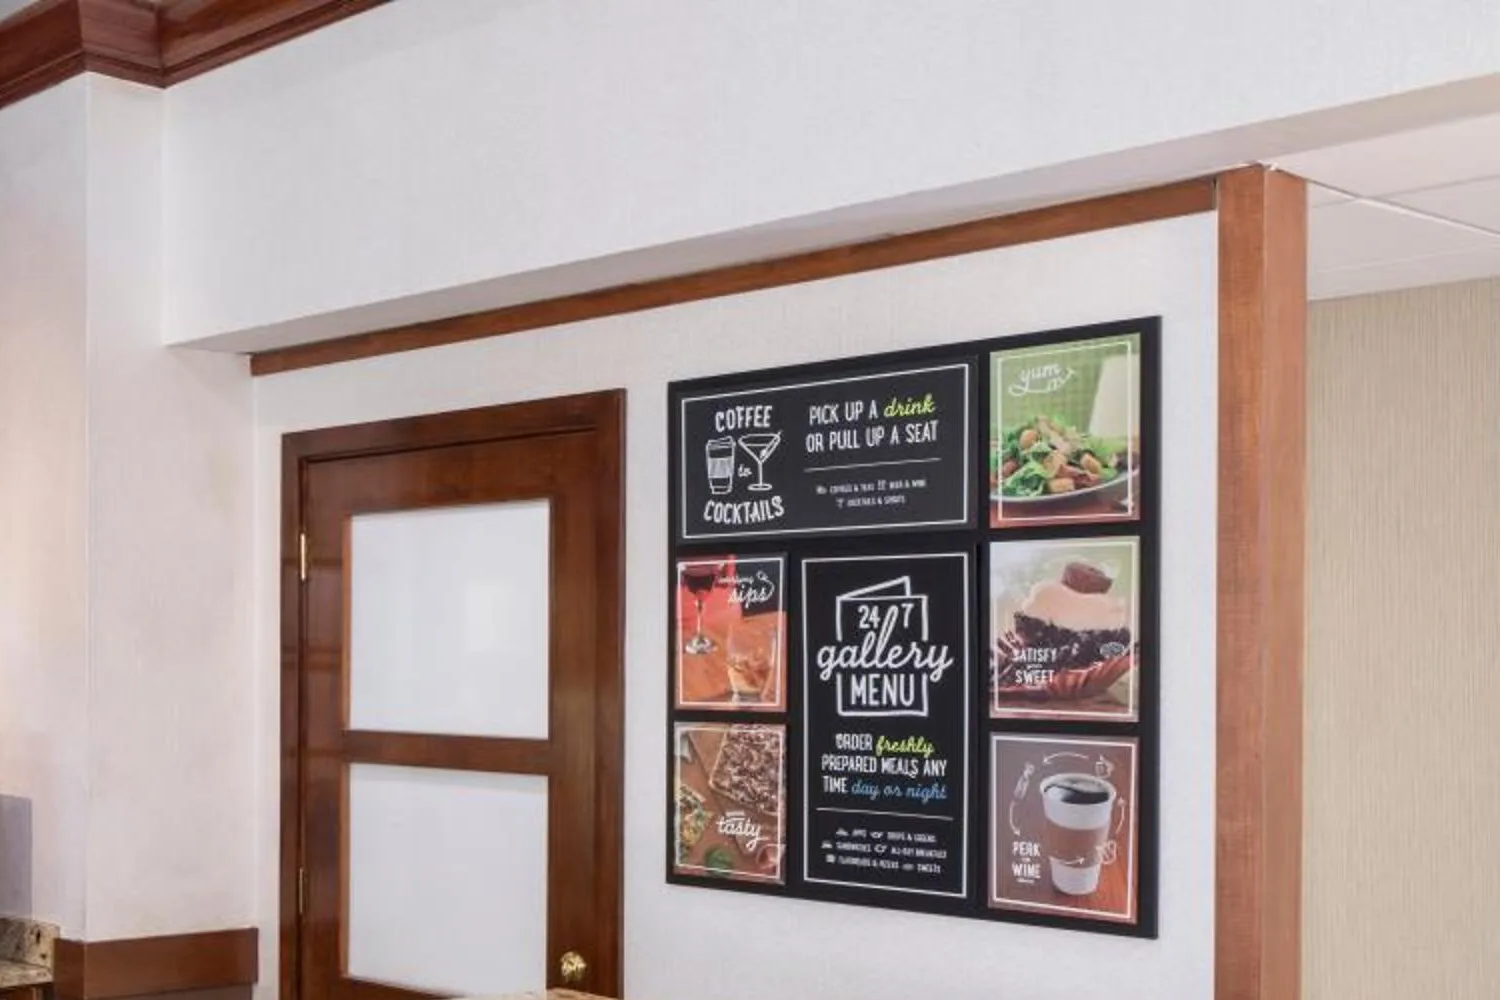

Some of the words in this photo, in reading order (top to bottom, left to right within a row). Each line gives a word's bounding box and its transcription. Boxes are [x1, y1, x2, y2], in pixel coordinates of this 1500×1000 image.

[715, 405, 773, 432] COFFEE
[809, 403, 839, 426] PICK
[845, 400, 863, 422] UP
[868, 400, 879, 419] A
[883, 393, 937, 418] drink
[805, 432, 825, 453] OR
[829, 427, 860, 450] PULL
[865, 424, 884, 447] UP
[890, 424, 900, 445] A
[905, 420, 939, 443] SEAT
[703, 496, 785, 524] COCKTAILS
[728, 584, 768, 609] sips
[857, 604, 881, 629] 24
[817, 604, 954, 683] gallery
[1011, 647, 1058, 663] SATISFY
[851, 673, 915, 706] MENU
[1015, 669, 1056, 685] SWEET
[835, 733, 873, 750] ORDER
[876, 735, 935, 759] freshly
[821, 754, 877, 773] PREPARED
[881, 757, 919, 779] MEALS
[923, 760, 948, 777] ANY
[822, 775, 849, 794] TIME
[851, 779, 881, 800] day
[883, 786, 903, 798] or
[906, 784, 948, 805] night
[716, 816, 768, 852] tasty
